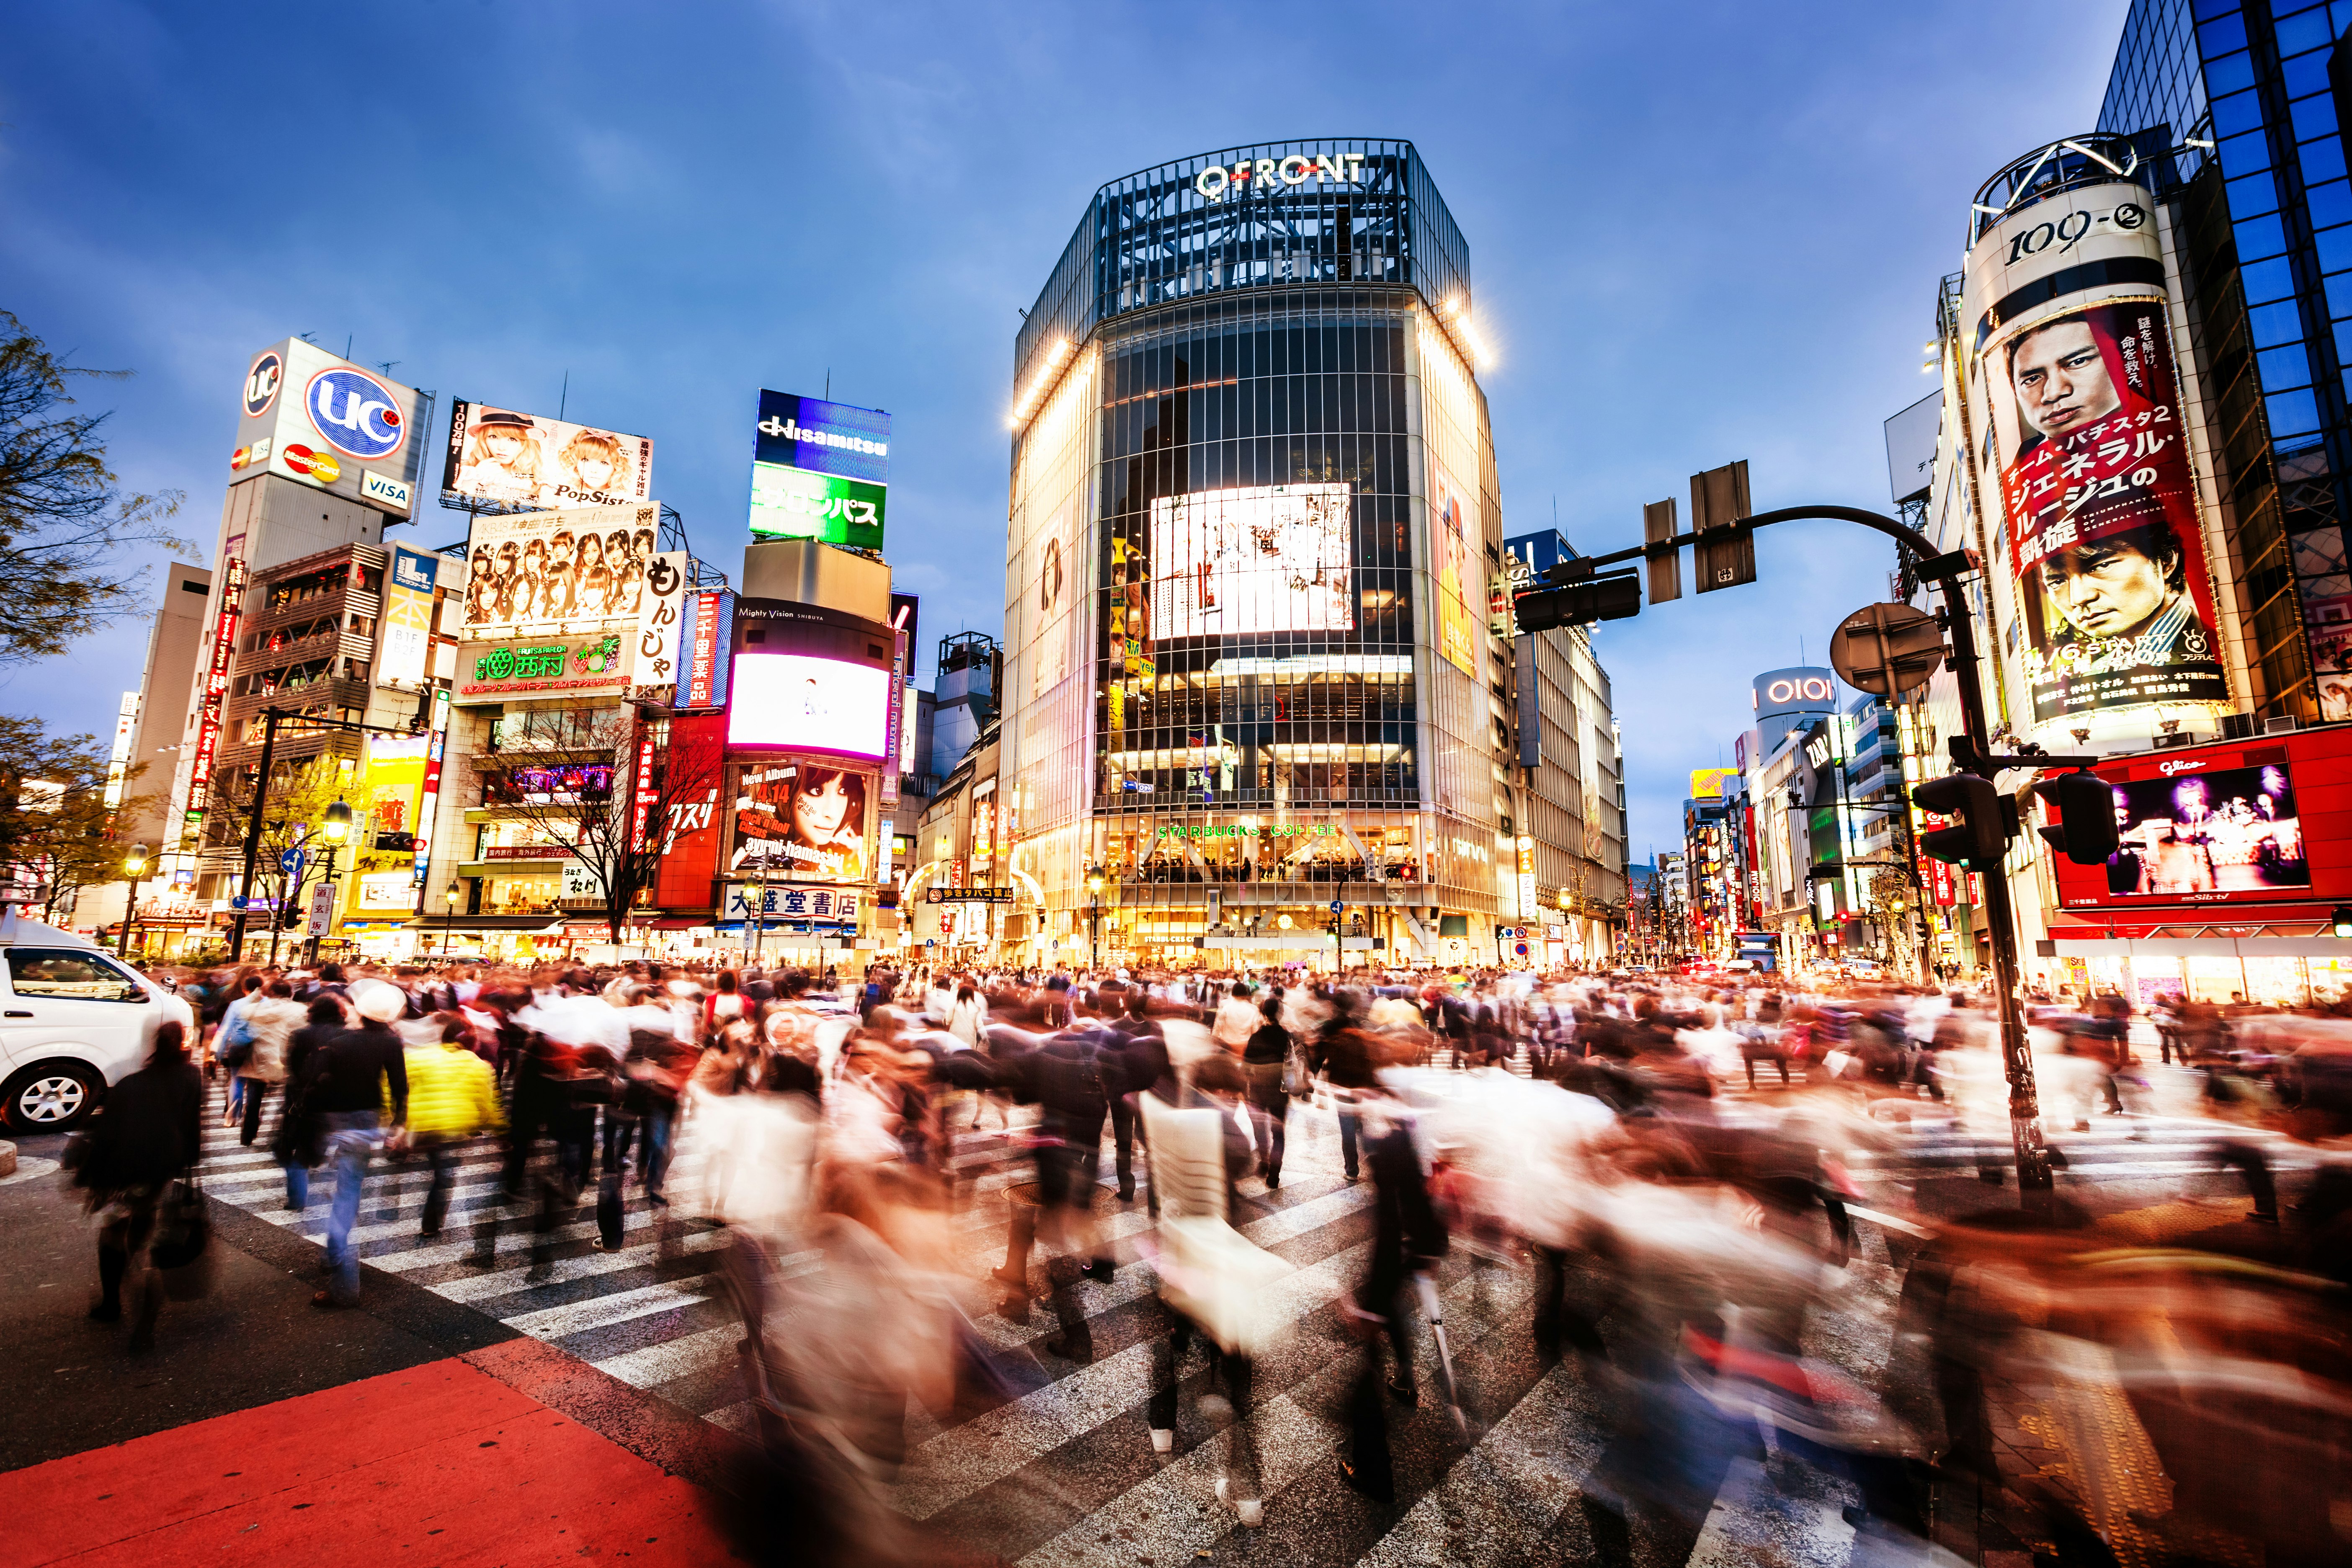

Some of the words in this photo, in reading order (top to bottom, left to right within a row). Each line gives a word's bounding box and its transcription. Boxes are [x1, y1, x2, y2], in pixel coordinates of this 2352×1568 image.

[1197, 153, 1364, 203] QFRONT
[2138, 317, 2158, 369] 謎を解け。
[2120, 336, 2143, 387] 命を救え。
[2008, 405, 2171, 486] チーム・バチスタ2
[284, 450, 340, 476] MasterCard
[636, 441, 649, 497] 最強のギャル雑誌
[368, 477, 406, 502] VISA
[760, 486, 878, 526] サロンパス
[2015, 466, 2158, 541] ルージュの
[2082, 497, 2146, 519] TRIUMPHANT
[2152, 490, 2182, 499] RETURN
[2084, 514, 2131, 531] GENERAL
[2136, 505, 2166, 515] ROUGE
[2019, 517, 2079, 565] 凱旋
[397, 556, 406, 575] BOOK
[396, 576, 431, 590] ブックファースト
[641, 557, 680, 678] もんじゃ
[739, 608, 766, 618] Mighty
[769, 610, 793, 619] Vision
[396, 630, 417, 643] B1F
[690, 596, 714, 700] 三千里薬品
[2086, 634, 2167, 655] START
[517, 646, 567, 655] FRUITS&PARLOR
[475, 658, 486, 680] 渋谷
[515, 655, 565, 678] 西村
[742, 773, 763, 786] New
[765, 766, 796, 782] Album
[2159, 760, 2206, 776] Glico
[757, 783, 790, 803] 4.14
[747, 799, 754, 808] in
[755, 800, 776, 813] stores
[353, 813, 364, 843] 渋谷駅前
[738, 820, 768, 839] Circus
[739, 808, 790, 835] Rock'n'Roll
[1158, 825, 1260, 839] STARBUCKS
[1271, 824, 1337, 837] COFFEE
[745, 837, 784, 855] ayumi
[785, 841, 845, 869] hamasaki
[570, 878, 597, 894] 松川
[944, 889, 1012, 897] 歩きタバコ禁止
[1806, 880, 1815, 905] ZARA
[311, 889, 327, 930] 道玄坂
[730, 890, 857, 916] 大盛堂書店
